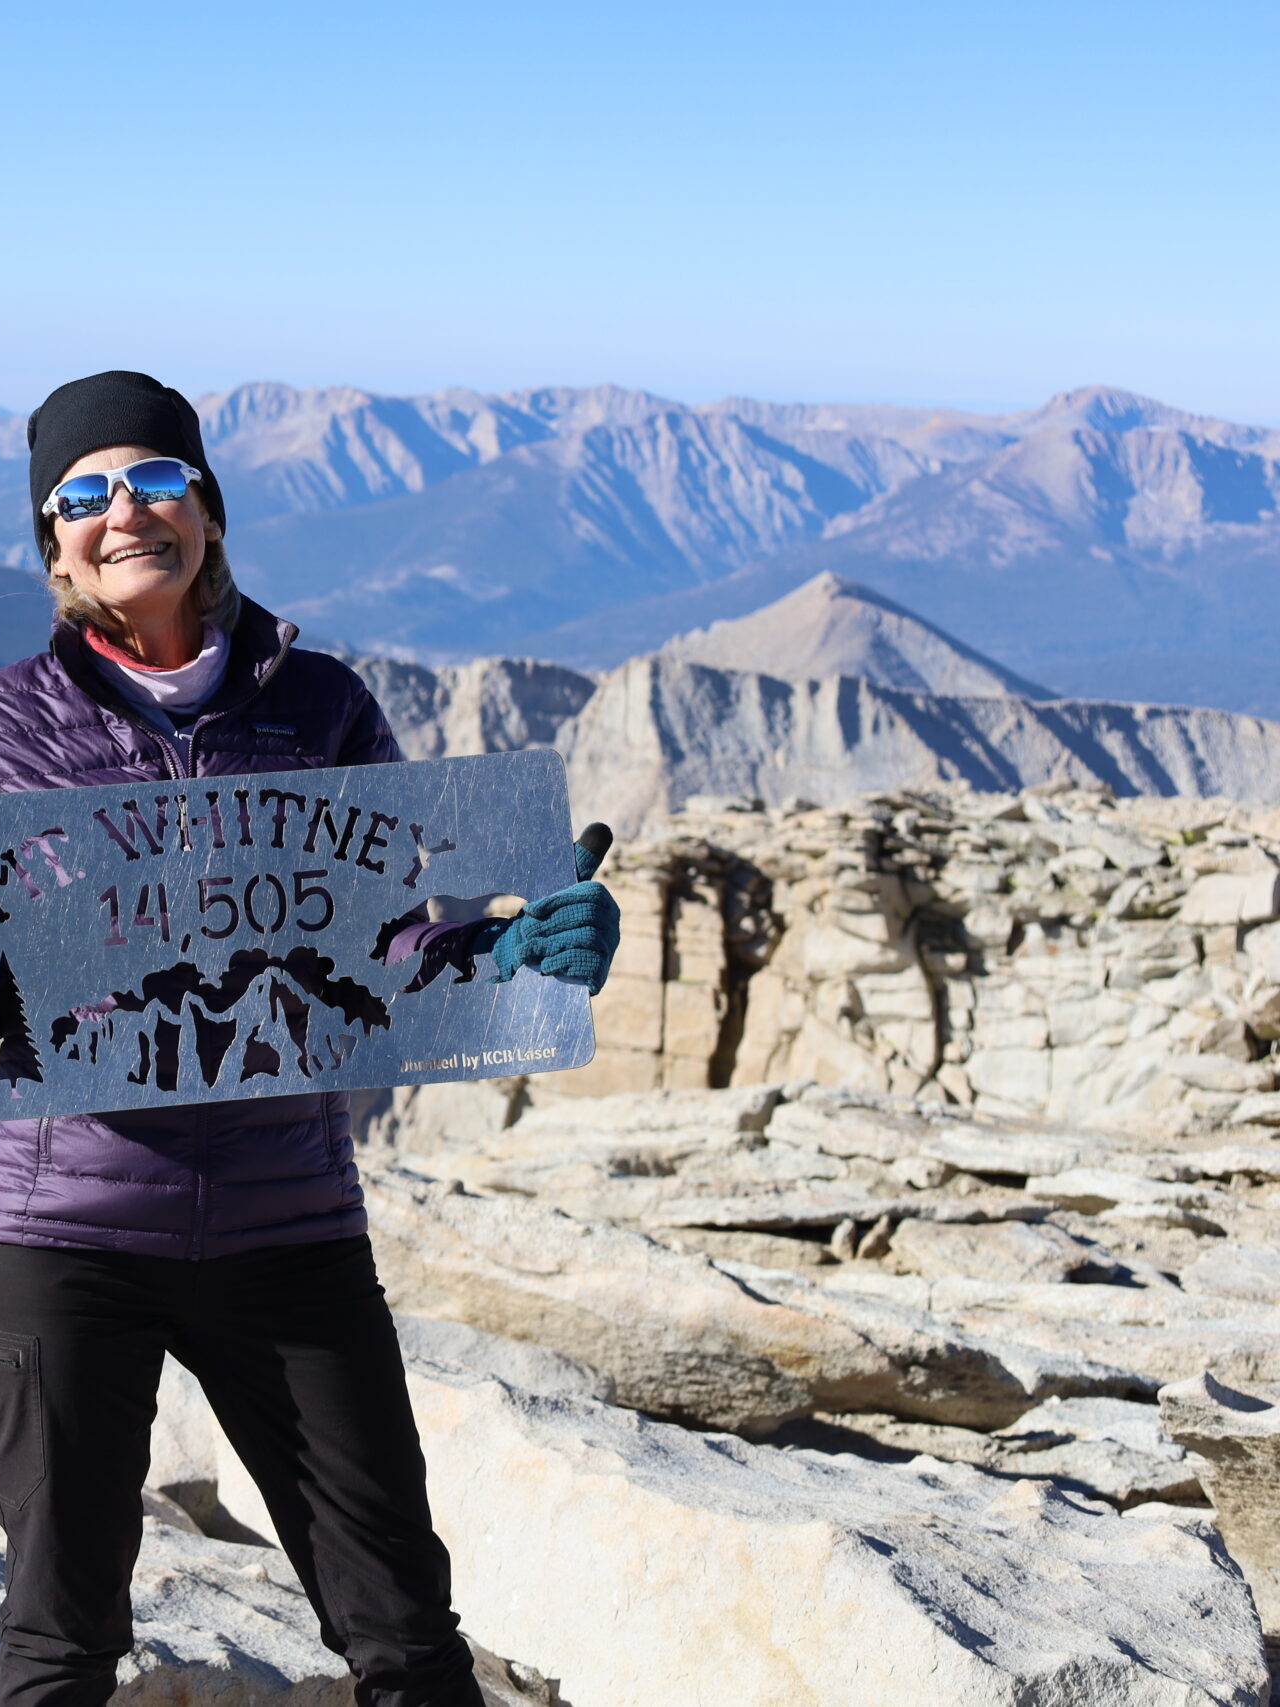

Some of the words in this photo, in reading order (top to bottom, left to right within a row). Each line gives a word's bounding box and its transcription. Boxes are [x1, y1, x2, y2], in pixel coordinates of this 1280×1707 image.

[256, 726, 295, 736] patagonia
[93, 789, 457, 889] WHITNEY
[99, 869, 334, 953] 14,505
[462, 1053, 479, 1071] by
[483, 1050, 512, 1066] KCB
[517, 1047, 558, 1062] Laser
